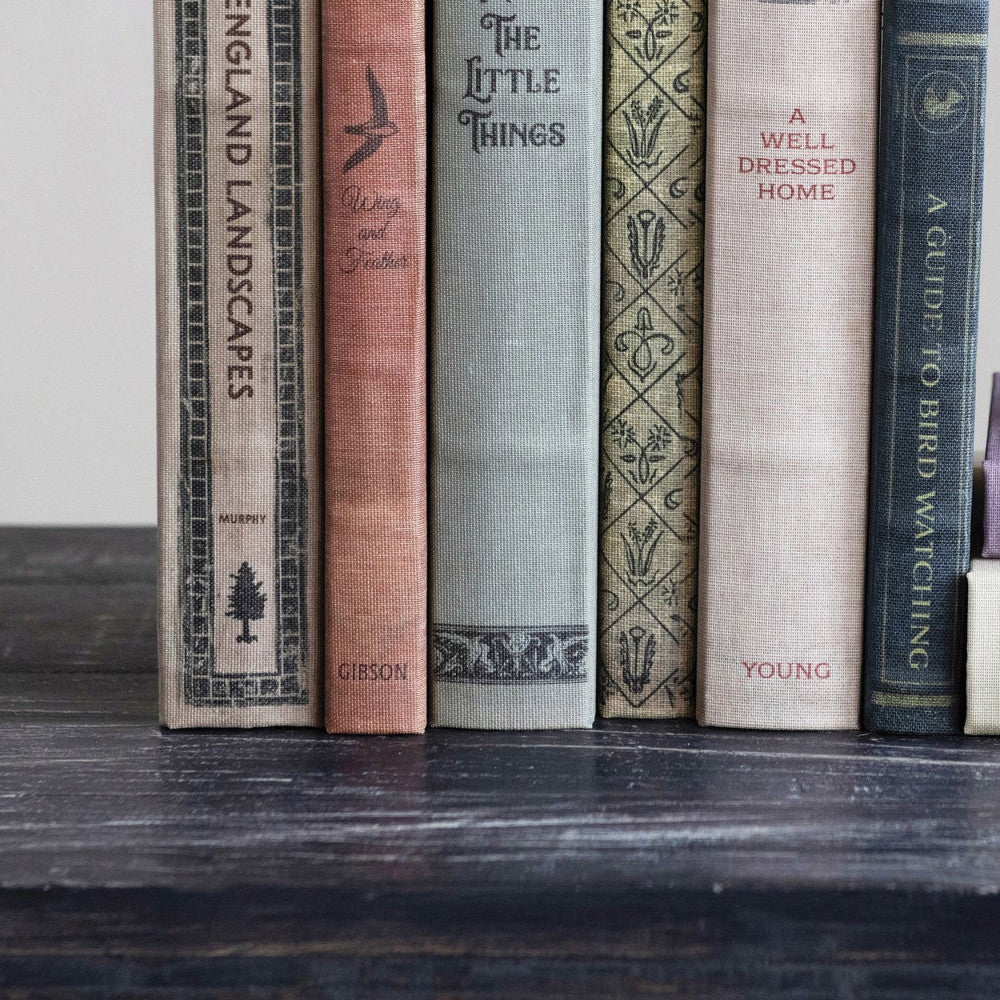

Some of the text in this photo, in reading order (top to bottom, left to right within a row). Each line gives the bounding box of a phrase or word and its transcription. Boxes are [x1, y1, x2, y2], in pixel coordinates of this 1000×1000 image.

[480, 13, 541, 58] THE
[462, 54, 561, 102] LITTLE
[788, 107, 806, 125] A
[457, 108, 566, 154] THINGS
[760, 131, 835, 150] WELL
[738, 156, 857, 175] DRESSED
[342, 185, 402, 218] Wing
[758, 182, 836, 201] HOME
[357, 220, 390, 241] and
[338, 246, 408, 274] Feather
[225, 179, 254, 400] LANDSCAPES
[909, 194, 949, 671] A GUIDE TO BIRD WATCHING
[218, 513, 267, 525] MURPHY
[338, 662, 408, 681] GIBSON
[742, 660, 832, 680] YOUNG
